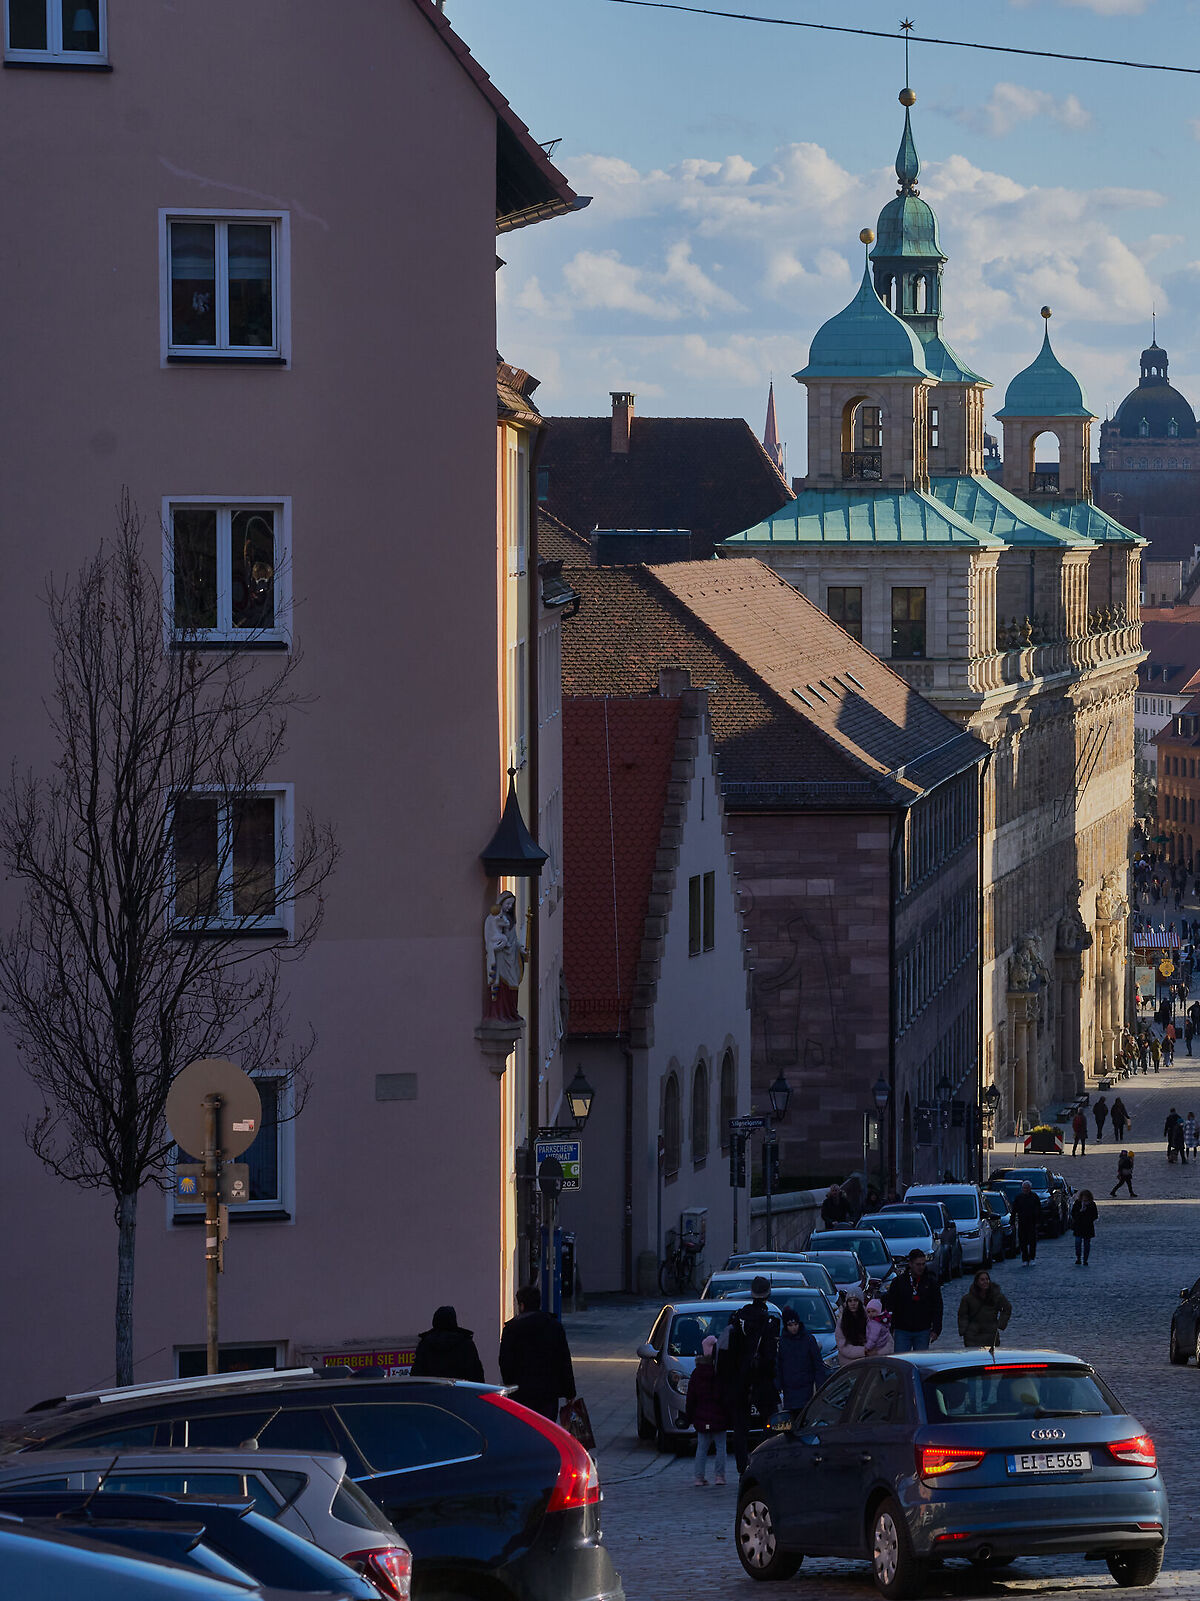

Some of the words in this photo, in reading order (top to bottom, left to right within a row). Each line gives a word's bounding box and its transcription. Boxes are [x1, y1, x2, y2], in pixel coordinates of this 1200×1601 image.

[538, 1144, 577, 1154] PARKSCHEIN-
[325, 1355, 374, 1368] WERBEN
[376, 1353, 395, 1366] SIE
[1021, 1455, 1038, 1470] EI
[1046, 1454, 1055, 1469] E
[1057, 1453, 1082, 1468] 565
